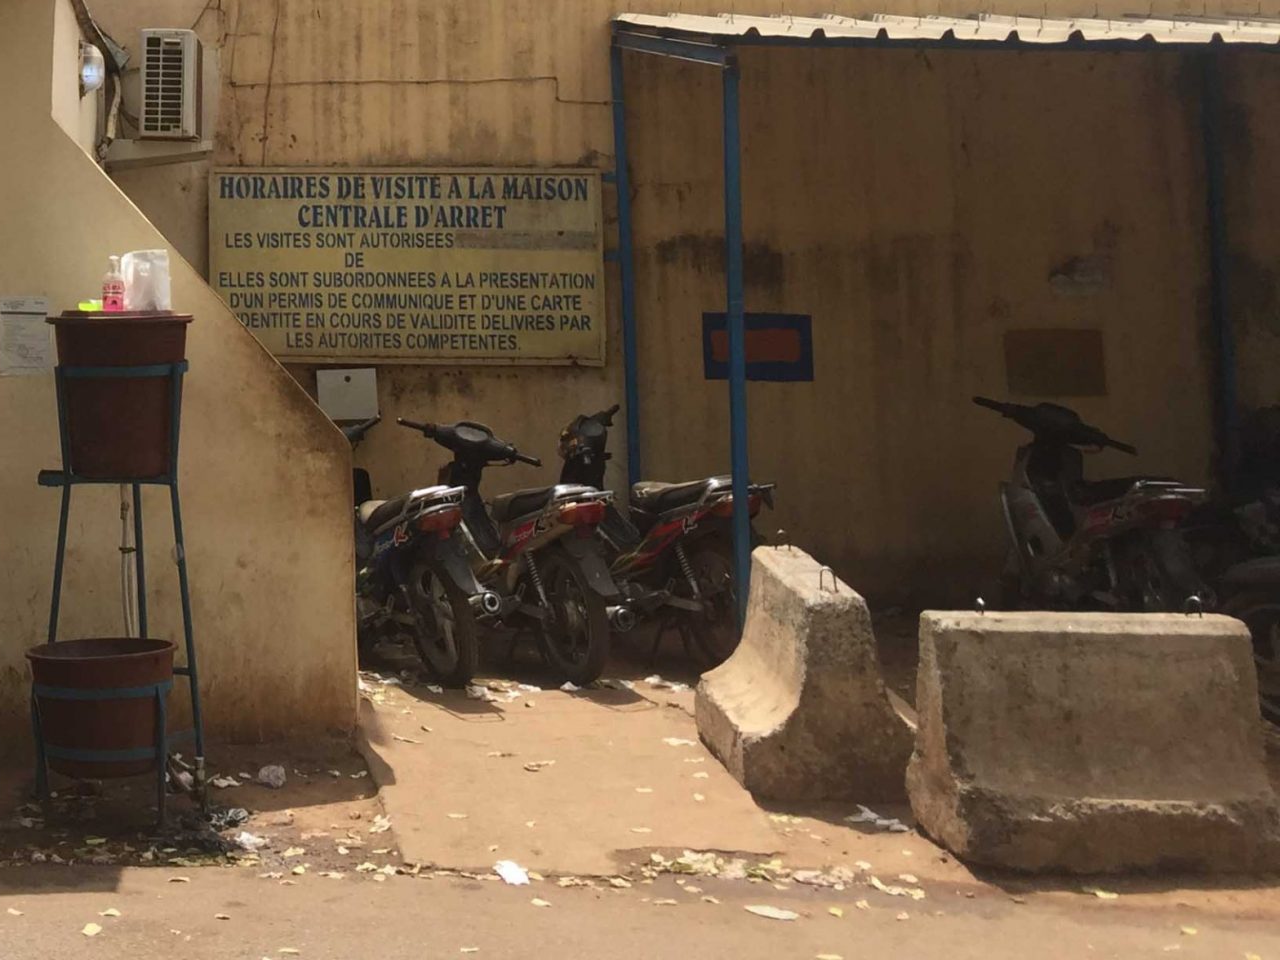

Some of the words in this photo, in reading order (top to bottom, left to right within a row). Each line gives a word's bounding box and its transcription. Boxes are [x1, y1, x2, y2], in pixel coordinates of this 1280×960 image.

[220, 176, 330, 199] HORAIRES
[337, 176, 365, 199] DE
[371, 176, 441, 199] VISITE
[447, 176, 462, 199] A
[469, 176, 495, 199] LA
[501, 176, 588, 201] MAISON
[298, 204, 407, 228] CENTRALE
[415, 205, 506, 229] D'ARRET
[225, 232, 253, 248] LES
[257, 232, 311, 248] VISITES
[316, 232, 356, 248] SONT
[360, 232, 454, 248] AUTORISEES
[345, 252, 364, 268] DE
[220, 272, 265, 288] ELLES
[270, 272, 308, 288] SONT
[313, 271, 436, 288] SUBORDONNEES
[440, 272, 452, 288] A
[456, 272, 475, 288] LA
[479, 272, 595, 289] PRESENTATION
[230, 293, 263, 309] D'UN
[269, 293, 323, 309] PERMIS
[328, 293, 347, 309] DE
[352, 293, 453, 310] COMMUNIQUE
[458, 295, 477, 310] ET
[481, 294, 526, 310] D'UNE
[531, 294, 582, 311] CARTE
[237, 312, 301, 328] DENTITE
[306, 313, 325, 328] EN
[330, 313, 382, 329] COURS
[386, 313, 406, 329] DE
[410, 314, 476, 330] VALIDITE
[481, 314, 555, 330] DELIVRES
[560, 315, 591, 330] PAR
[286, 332, 313, 348] LES
[318, 333, 402, 349] AUTORITES
[406, 333, 521, 351] COMPETENTES.
